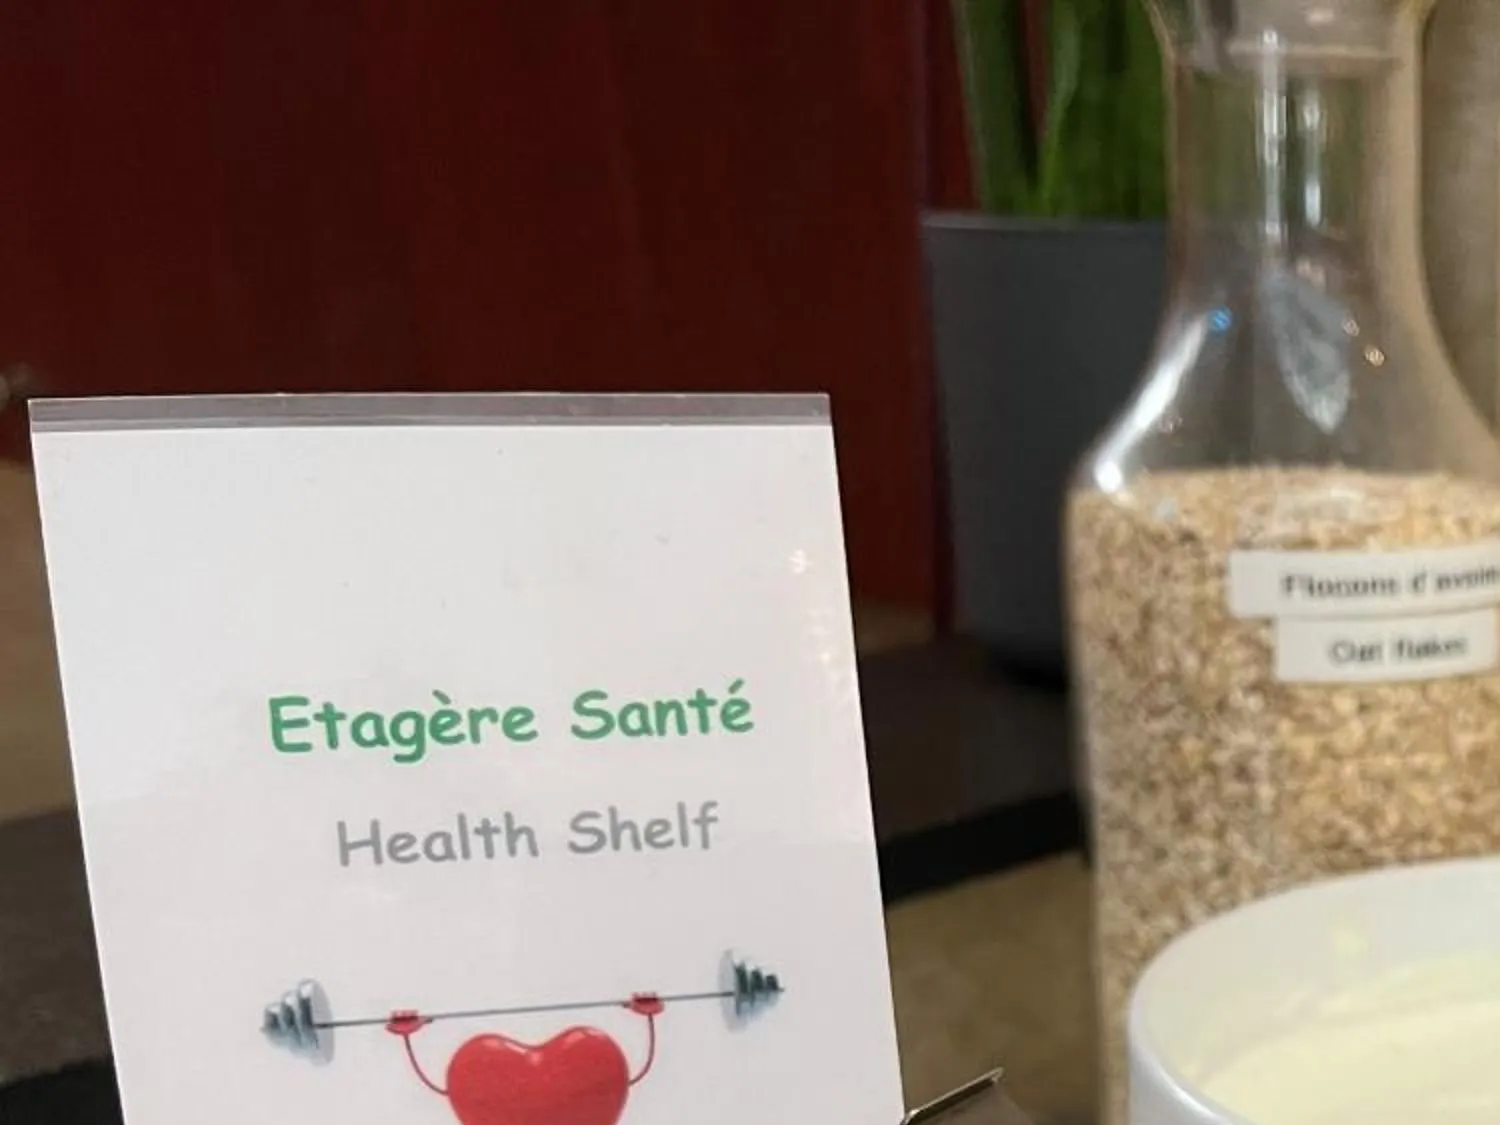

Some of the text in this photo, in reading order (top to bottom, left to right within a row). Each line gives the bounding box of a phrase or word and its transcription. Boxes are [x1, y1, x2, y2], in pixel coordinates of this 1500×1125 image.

[268, 678, 755, 763] Etagère Santé
[337, 801, 720, 867] Health Shelf
